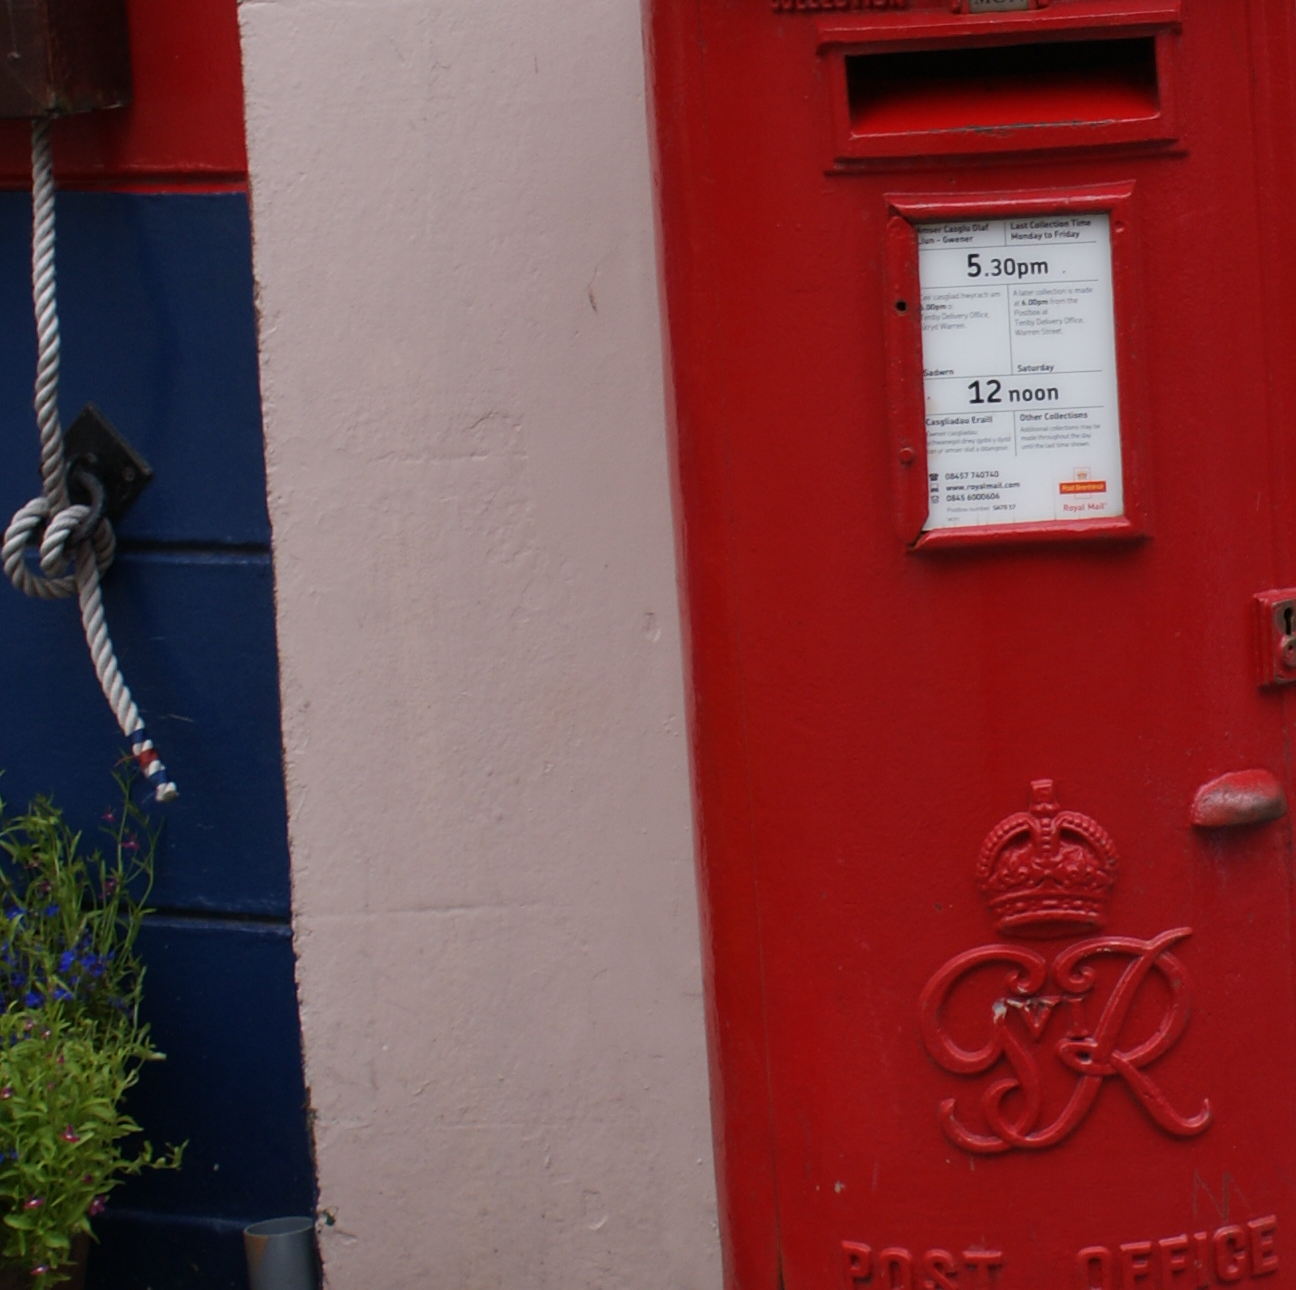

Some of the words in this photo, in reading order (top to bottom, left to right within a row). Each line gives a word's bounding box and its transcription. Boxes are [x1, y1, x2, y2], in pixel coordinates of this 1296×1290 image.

[1010, 222, 1028, 230] Last
[1030, 220, 1069, 229] Collection
[1071, 218, 1091, 227] Time
[1011, 232, 1042, 241] Monday
[1044, 231, 1052, 239] to
[1054, 230, 1080, 239] Friday
[967, 253, 1049, 279] 5.30pm
[1021, 299, 1049, 307] 6.00pm
[1017, 364, 1055, 373] Saturday
[968, 379, 1002, 404] 12
[1008, 387, 1059, 402] noon
[1020, 413, 1042, 421] Other
[1044, 411, 1088, 420] Collections
[970, 470, 999, 479] 740740
[946, 481, 1021, 491] www.royalmail.com
[1063, 503, 1084, 512] Royal
[1087, 502, 1105, 510] Mail
